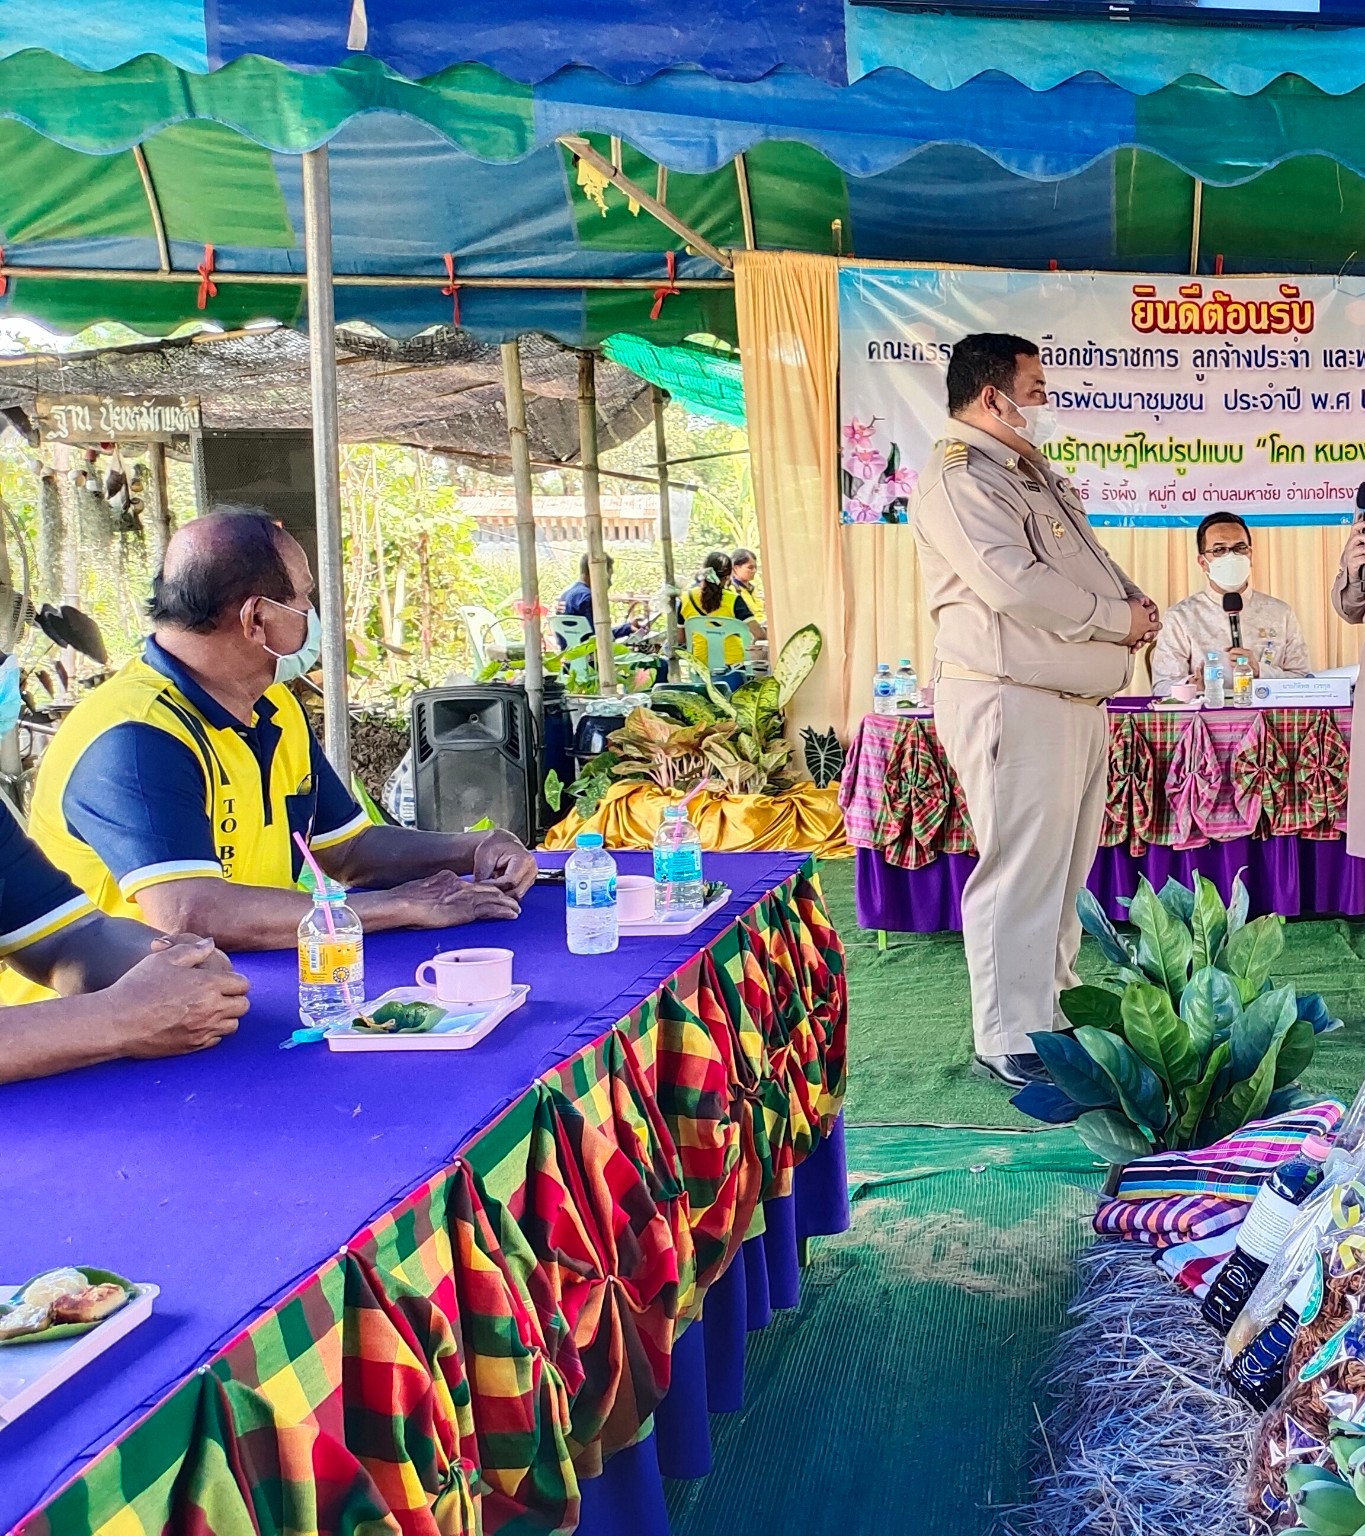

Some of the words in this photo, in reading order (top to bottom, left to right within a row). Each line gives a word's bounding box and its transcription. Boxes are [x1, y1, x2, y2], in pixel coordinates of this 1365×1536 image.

[1132, 283, 1315, 334] ยินดีต้อนรับ
[1192, 336, 1310, 381] ลูกจ้างประจำ
[1048, 381, 1203, 422] ารพัฒนาชุมชน
[1224, 382, 1301, 411] ประจำปี
[1312, 391, 1351, 411] พ.ศ
[45, 404, 93, 440] ฐาน
[1043, 432, 1243, 476] นรู้ทฤษฎีใหม่รูปแบบ
[1101, 479, 1137, 501] รังผึ้ง
[1149, 480, 1176, 509] หมู่ที่
[1182, 489, 1196, 501] ๗
[1202, 482, 1281, 502] ตำบลมหาชัย
[221, 798, 238, 834] TO
[219, 844, 236, 879] BE
